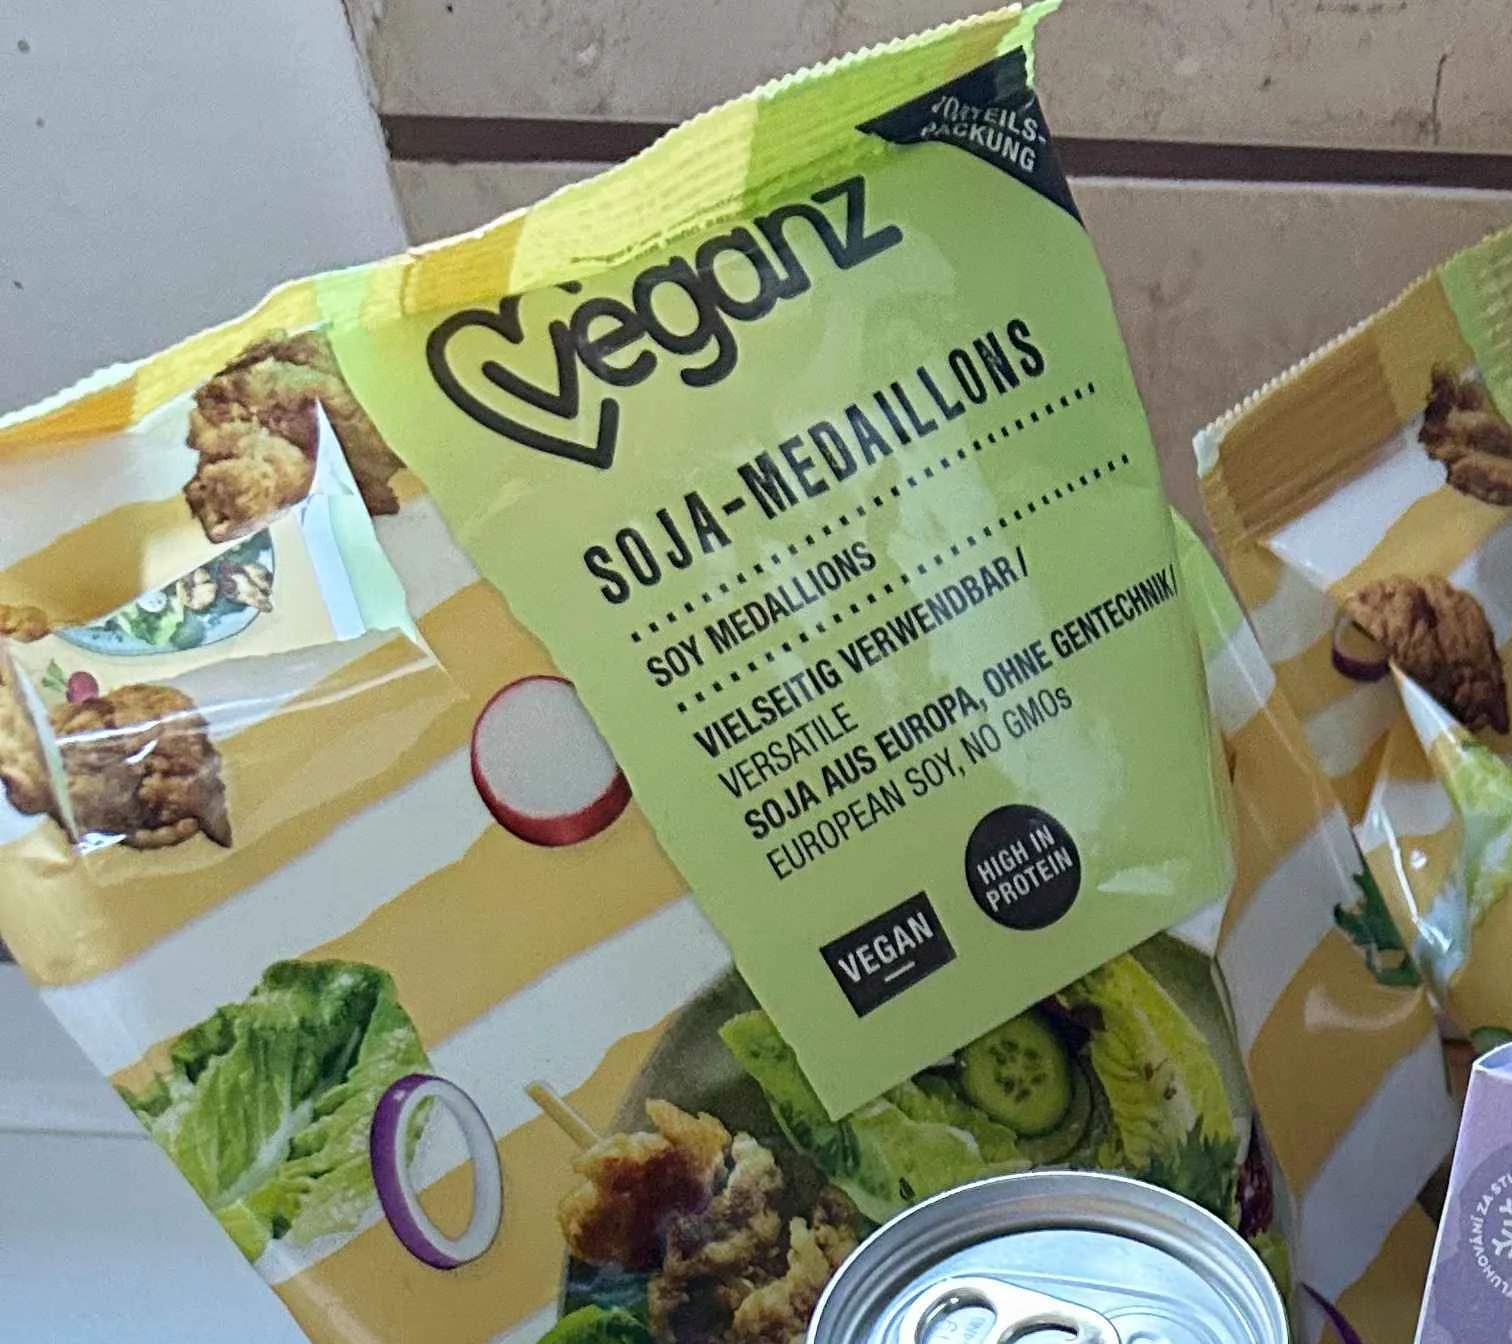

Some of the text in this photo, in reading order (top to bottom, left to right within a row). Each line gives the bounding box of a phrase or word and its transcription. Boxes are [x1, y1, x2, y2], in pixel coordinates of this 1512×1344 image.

[583, 319, 1044, 604] SOJA-MEDAILLONS
[647, 542, 876, 687] SOY MEDALLIONS
[693, 659, 843, 758] VIELSEITIG
[717, 702, 859, 798] VERSATILE
[744, 780, 821, 839] SOJA
[821, 745, 877, 797] AUS
[874, 686, 987, 762] EUROPA,
[983, 640, 1053, 697] OHNE
[766, 687, 1072, 880] EUROPEAN SOY, NO GMOs
[977, 825, 1054, 884] HIGH IN
[986, 847, 1073, 912] PROTEIN
[838, 912, 933, 982] VEGAN
[1476, 1194, 1494, 1215] ZA
